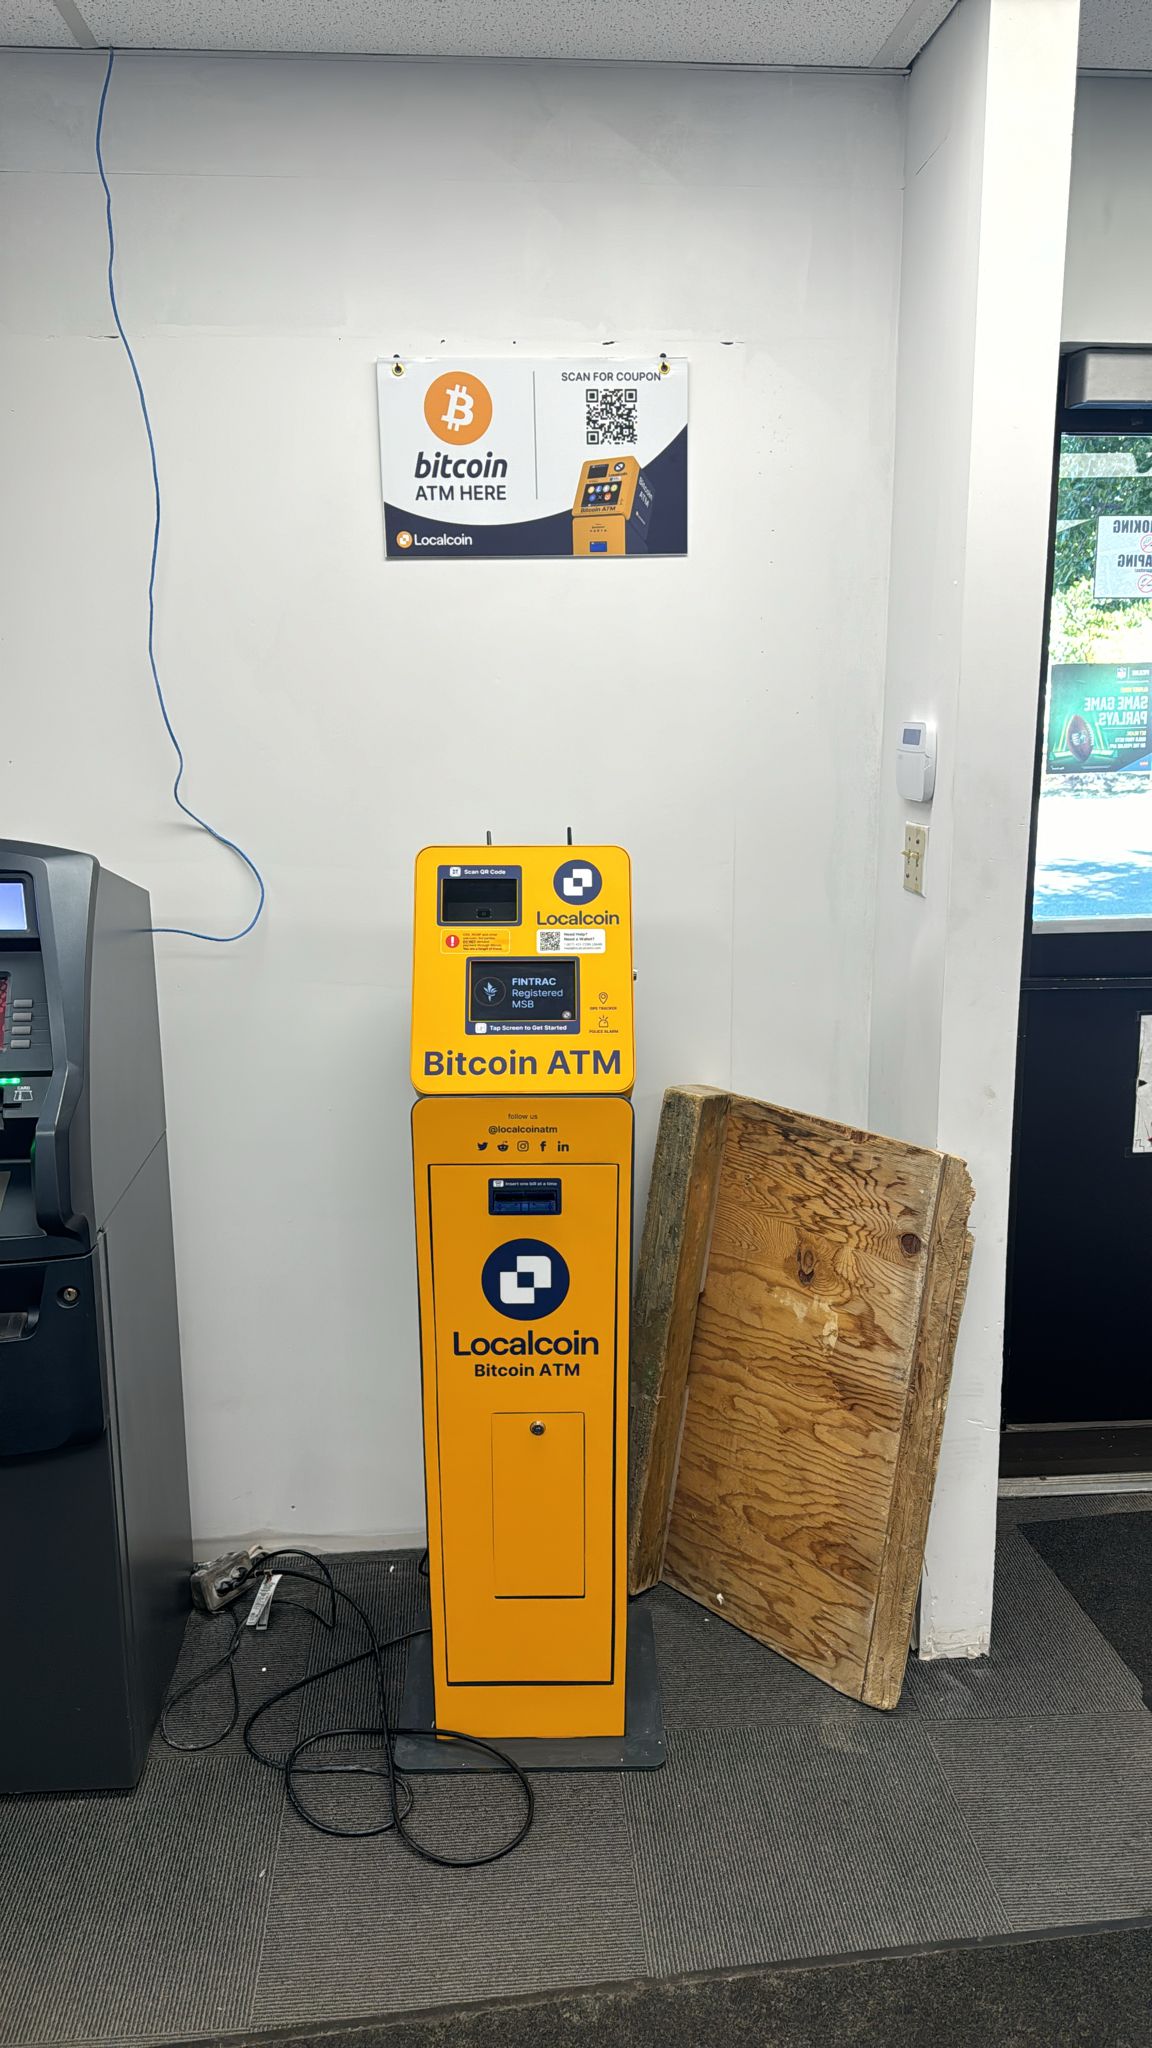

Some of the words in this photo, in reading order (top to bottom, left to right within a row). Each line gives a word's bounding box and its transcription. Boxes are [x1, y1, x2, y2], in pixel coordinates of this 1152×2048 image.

[562, 372, 590, 381] SCAN
[593, 372, 614, 381] FOR
[616, 372, 660, 381] COUPON
[414, 451, 508, 478] bitcoin
[416, 485, 454, 500] ATM
[460, 485, 506, 500] HERE
[414, 533, 472, 546] Localcoin
[537, 910, 620, 925] Localcoin
[512, 978, 556, 986] FINTRAC
[512, 988, 563, 999] Registered
[512, 1000, 534, 1008] MSB
[424, 1050, 537, 1076] Bitcoin
[547, 1050, 620, 1074] ATM
[488, 1126, 558, 1134] @localcoinatm
[453, 1330, 599, 1356] Localcoin
[474, 1363, 534, 1377] Bitcoin
[539, 1363, 580, 1376] ATM
